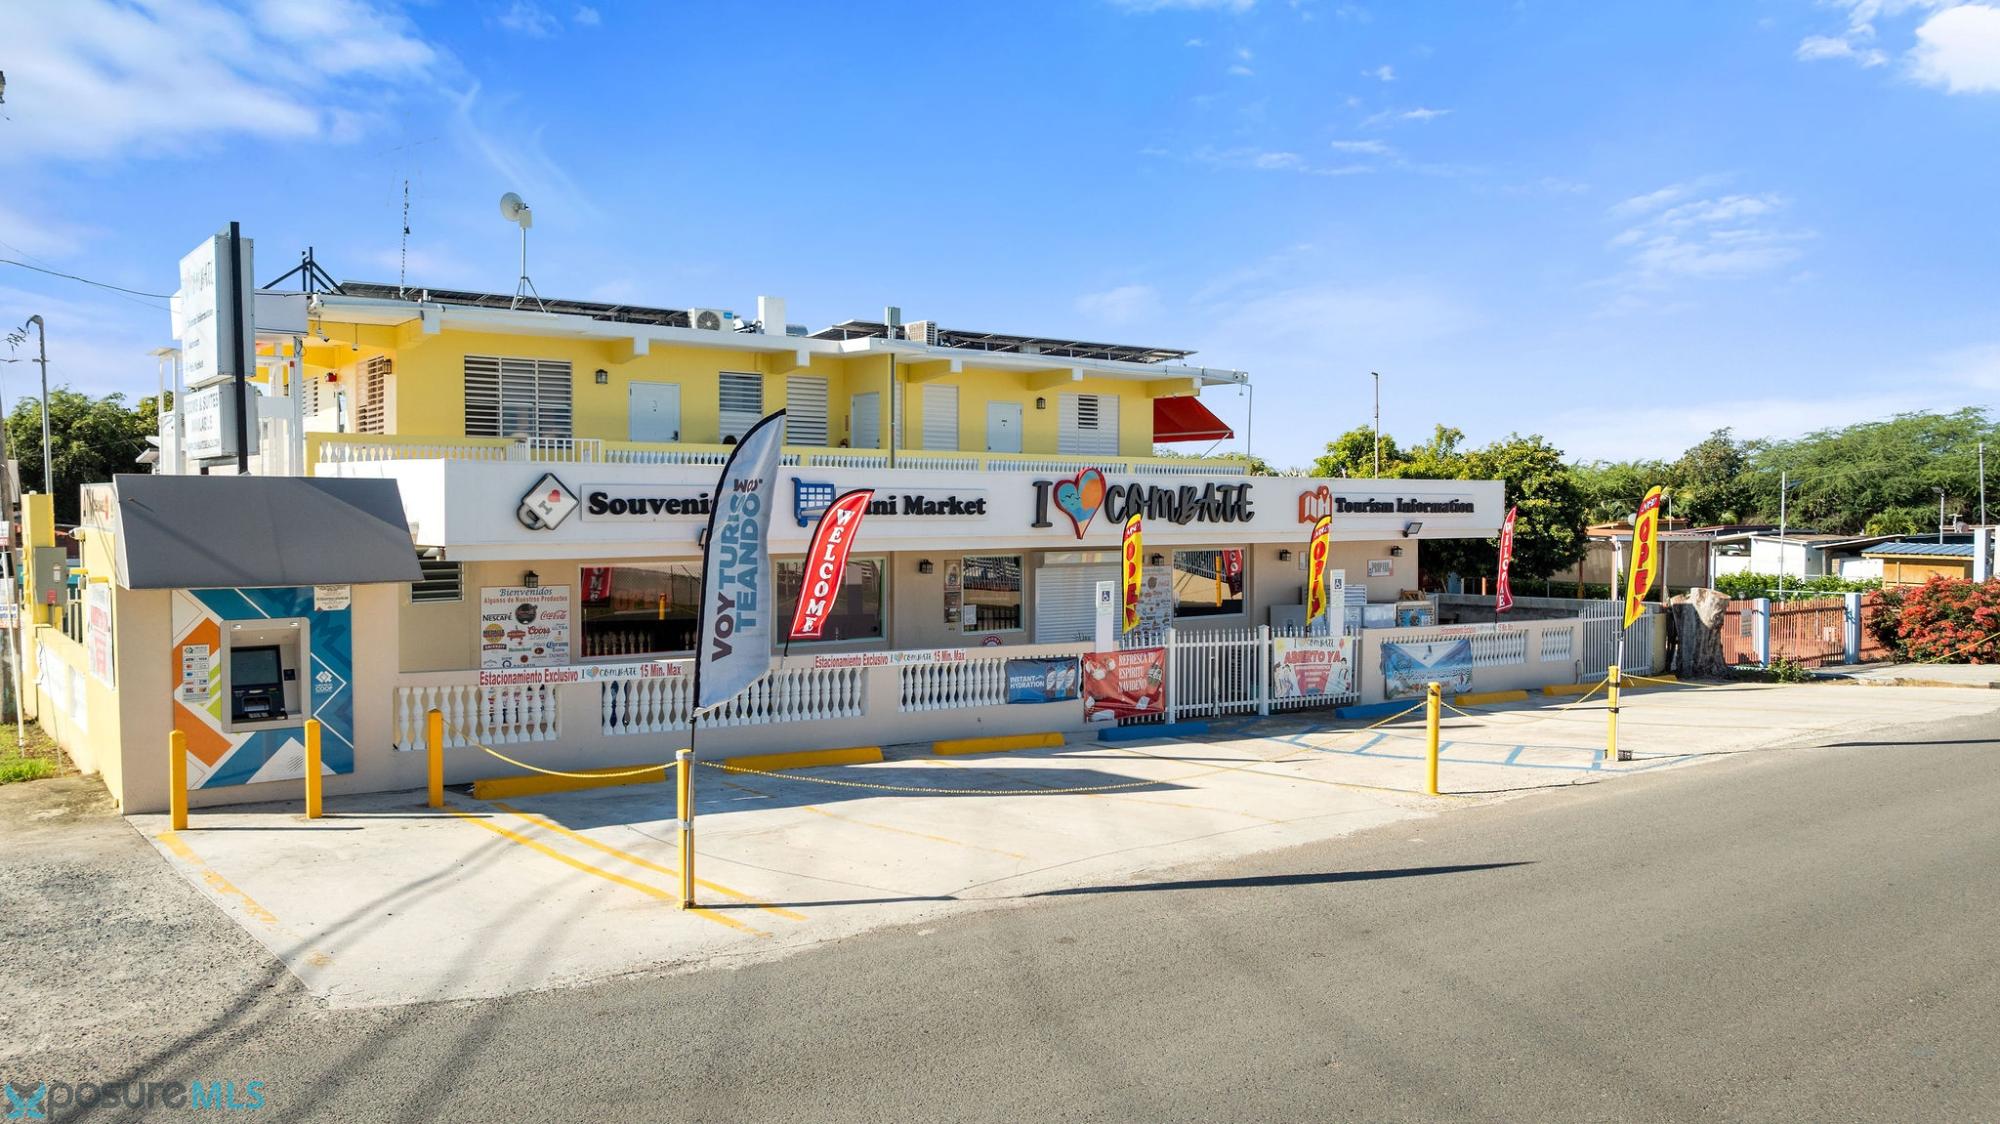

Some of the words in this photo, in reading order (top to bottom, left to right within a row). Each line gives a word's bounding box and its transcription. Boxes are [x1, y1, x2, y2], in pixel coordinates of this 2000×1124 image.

[902, 495, 987, 516] Market
[1031, 480, 1053, 528] I
[1105, 482, 1255, 525] COMBATE
[1335, 497, 1395, 514] Tourism
[1396, 497, 1475, 514] Information
[734, 492, 762, 633] TEANDO
[802, 509, 855, 633] WELCOME
[484, 597, 506, 605] Algunos
[499, 587, 553, 597] Bienvenidos
[711, 591, 735, 662] VOY
[815, 654, 861, 668] Estacionamiento
[862, 653, 888, 666] Exclusivo
[933, 650, 941, 662] 15
[942, 650, 953, 662] Min.
[954, 649, 965, 661] Max
[1118, 653, 1148, 666] REFRESCA
[1283, 650, 1326, 664] ABIERTO
[1327, 650, 1341, 663] YA
[479, 670, 543, 686] Estacionamiento
[544, 667, 579, 684] Exclusivo
[581, 669, 586, 680] I
[640, 664, 650, 677] 15
[650, 664, 666, 676] Min.
[667, 663, 682, 675] Max
[1010, 681, 1045, 689] HYDRATION
